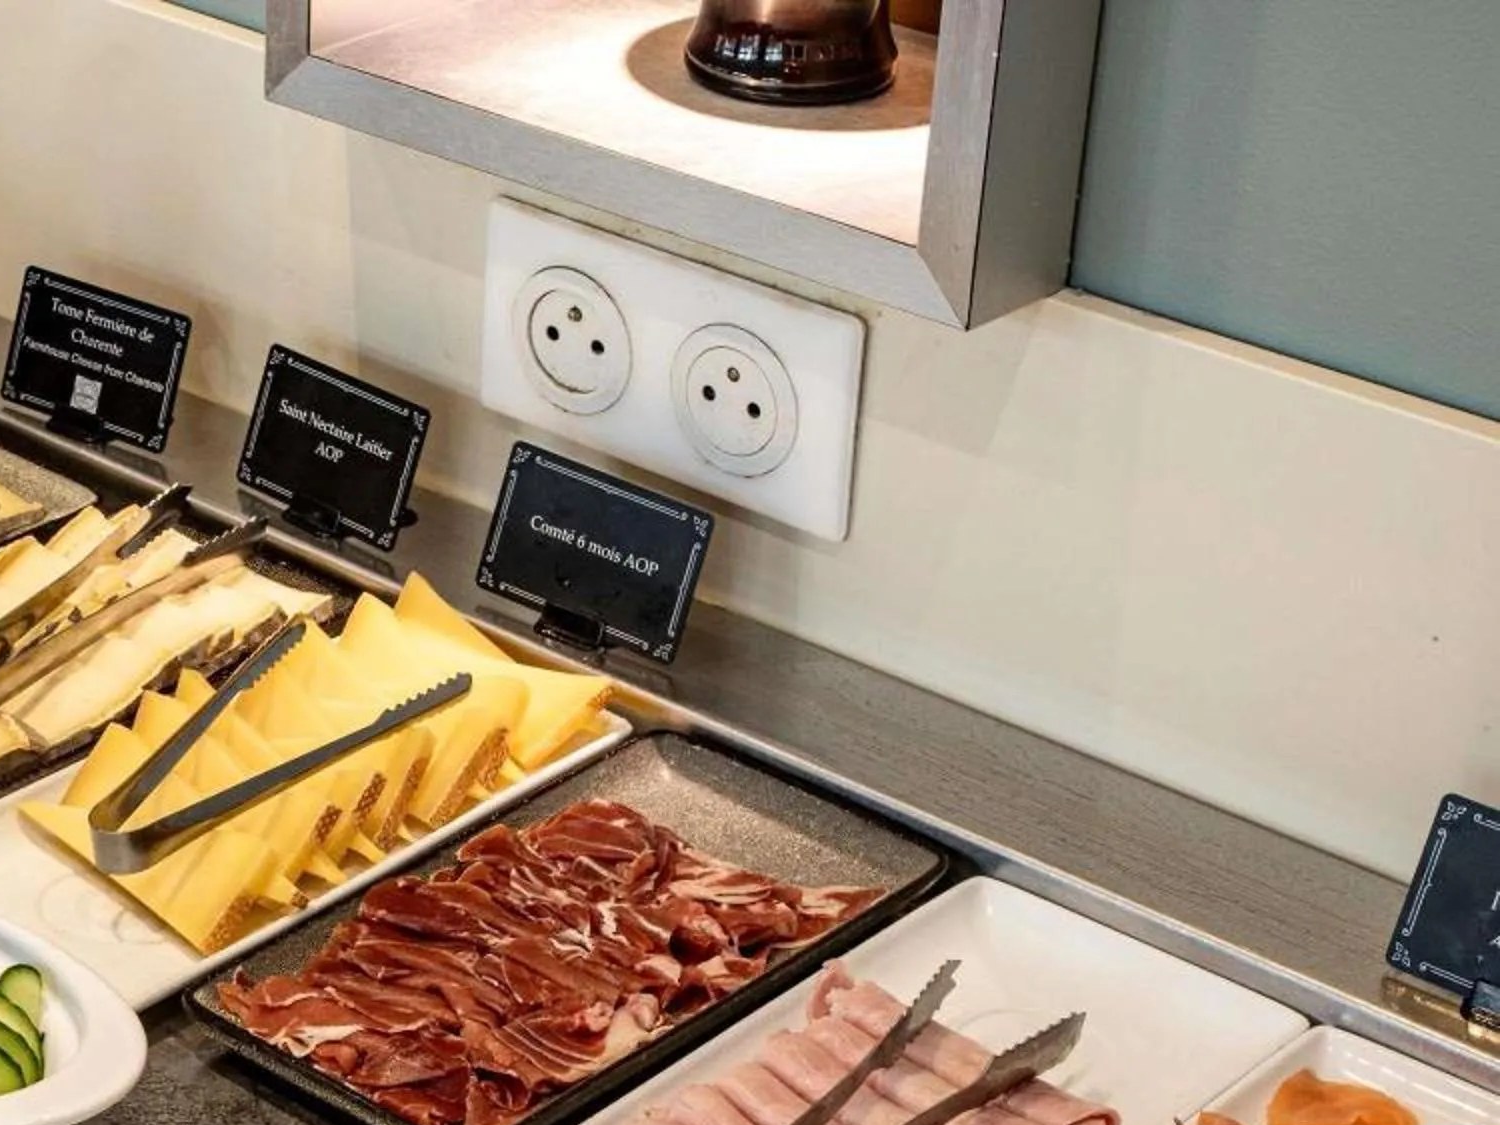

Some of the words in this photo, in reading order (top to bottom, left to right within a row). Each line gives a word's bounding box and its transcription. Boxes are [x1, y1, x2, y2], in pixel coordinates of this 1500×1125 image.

[52, 298, 85, 319] Tome
[85, 309, 137, 337] Fermière
[138, 327, 155, 343] de
[71, 328, 123, 357] Charente
[279, 399, 308, 423] Saint
[307, 411, 356, 445] Nectaire
[355, 433, 394, 461] Laitier
[314, 441, 344, 464] AOP
[530, 515, 575, 544] Comté
[577, 533, 586, 549] 6
[587, 541, 621, 563] mois
[623, 553, 660, 577] AOP
